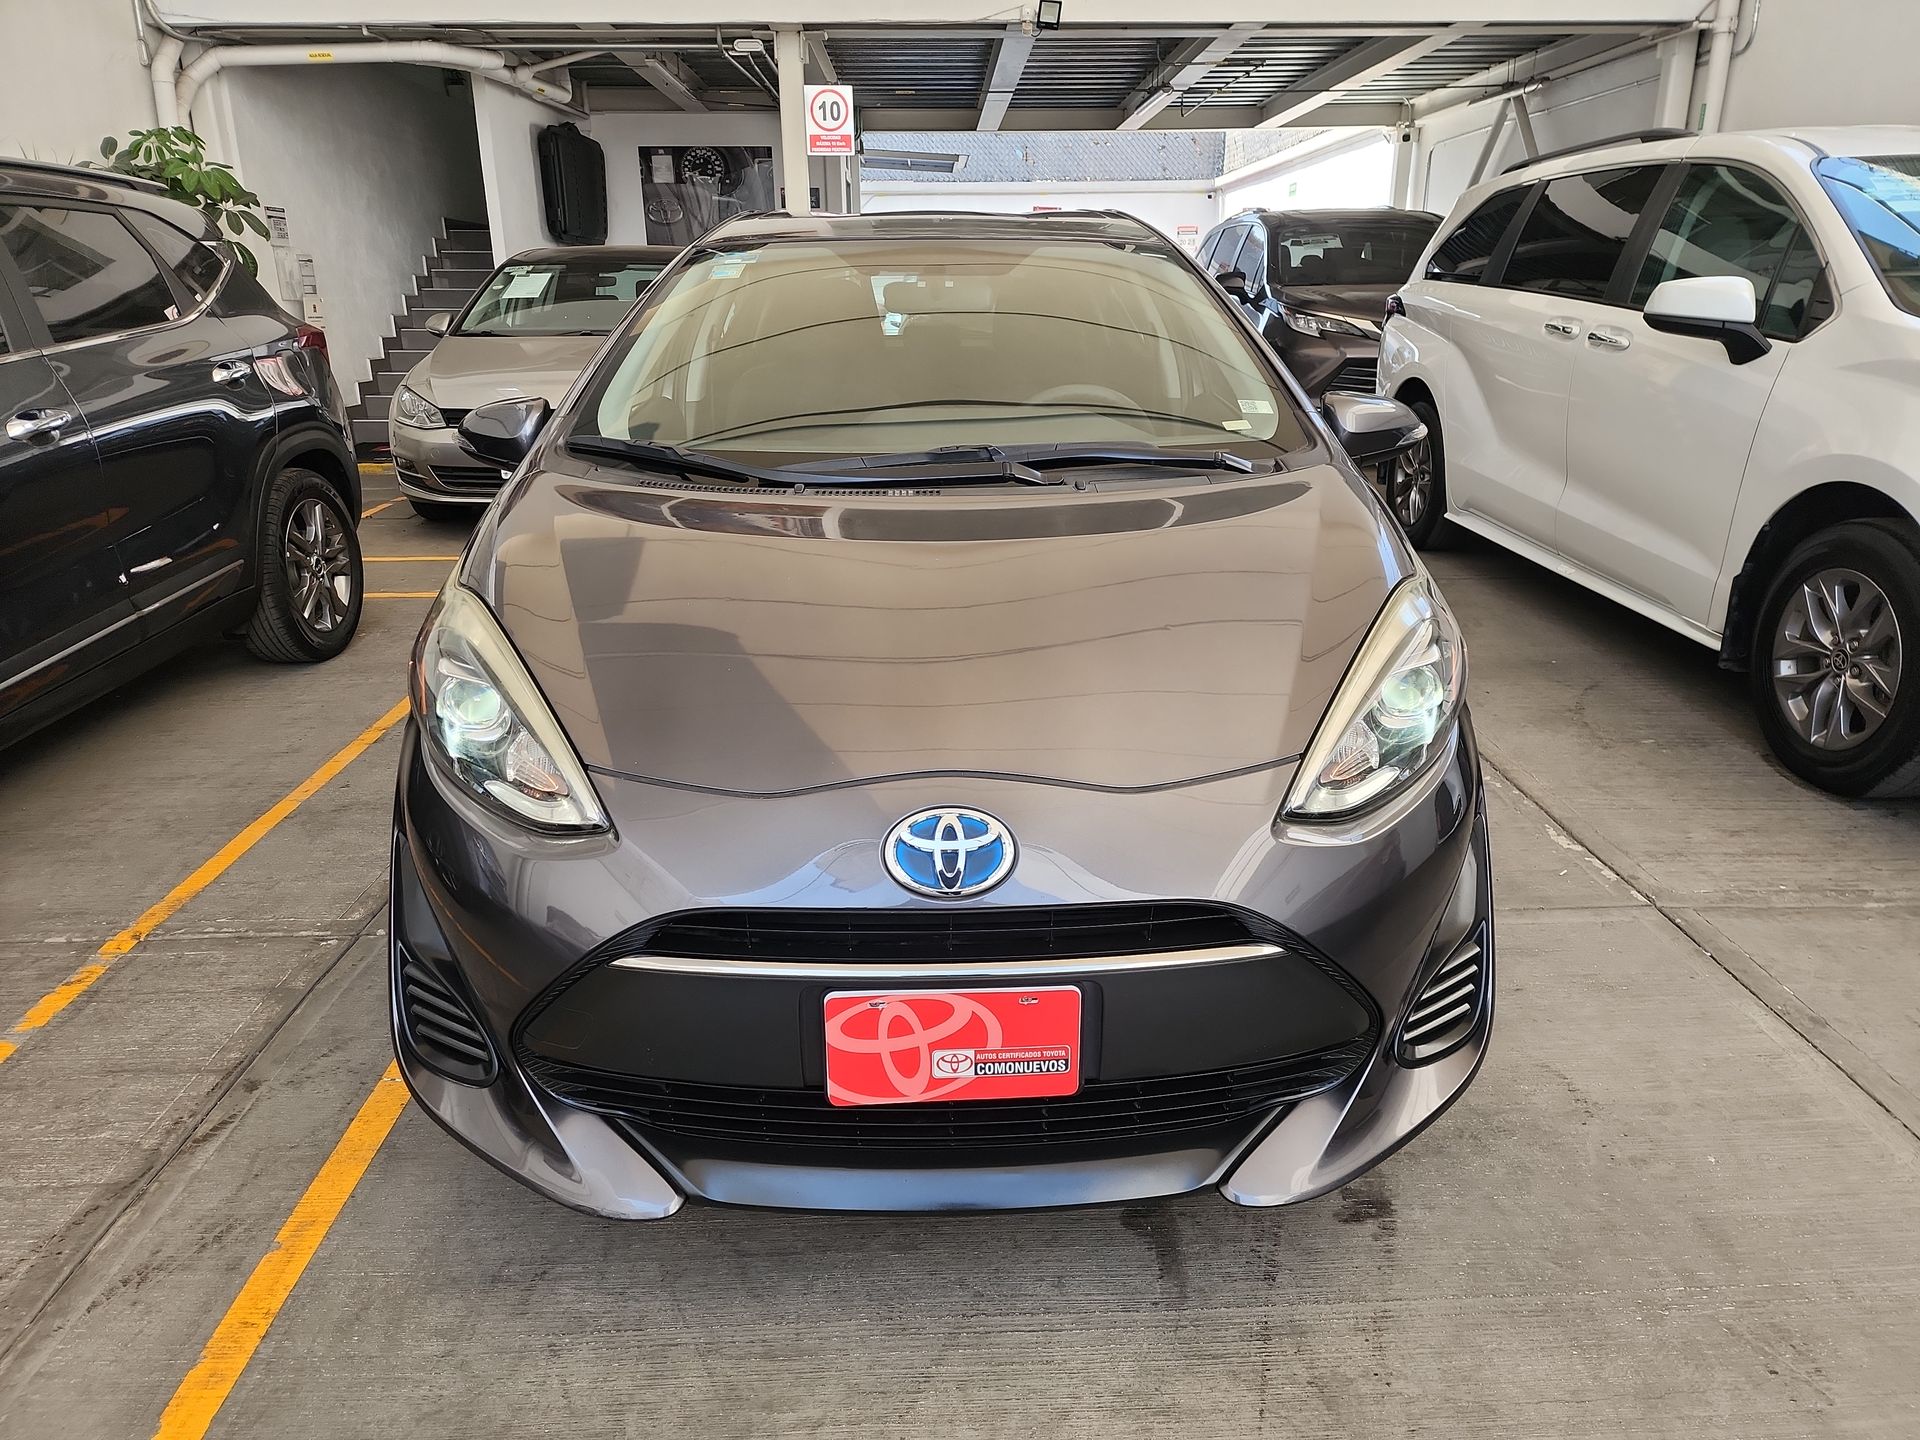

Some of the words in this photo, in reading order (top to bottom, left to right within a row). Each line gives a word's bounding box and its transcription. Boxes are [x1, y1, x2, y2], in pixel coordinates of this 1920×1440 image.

[818, 101, 841, 121] 10
[976, 1052, 996, 1060] AUTOS
[998, 1051, 1041, 1059] CERTIFICADOS
[976, 1060, 1066, 1075] COMONUEVOS
